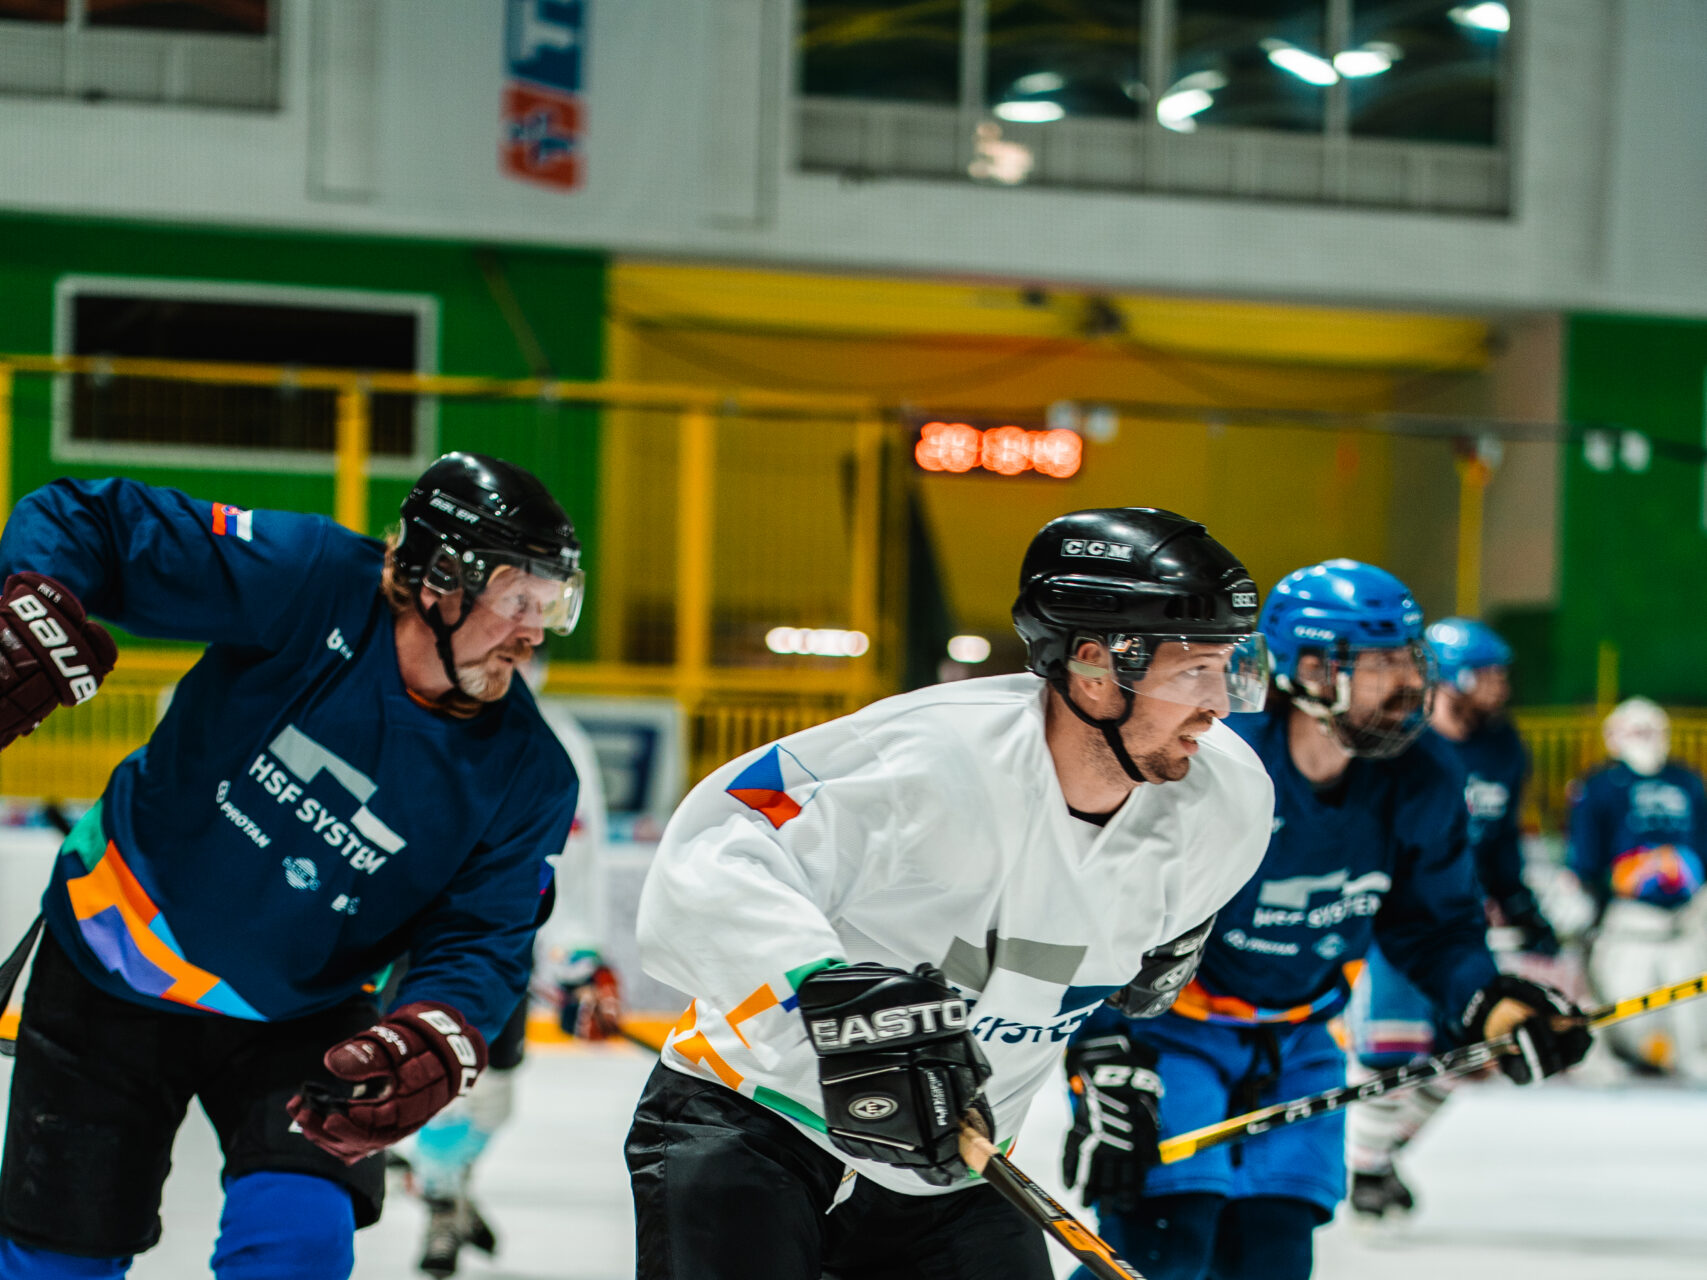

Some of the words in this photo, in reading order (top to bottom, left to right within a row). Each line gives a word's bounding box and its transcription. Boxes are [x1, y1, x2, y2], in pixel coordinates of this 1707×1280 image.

[1061, 539, 1134, 561] CCM
[8, 594, 99, 706] BAUE
[219, 801, 272, 849] PROTAN
[249, 753, 303, 804] HSF
[295, 798, 388, 875] SYSTEM
